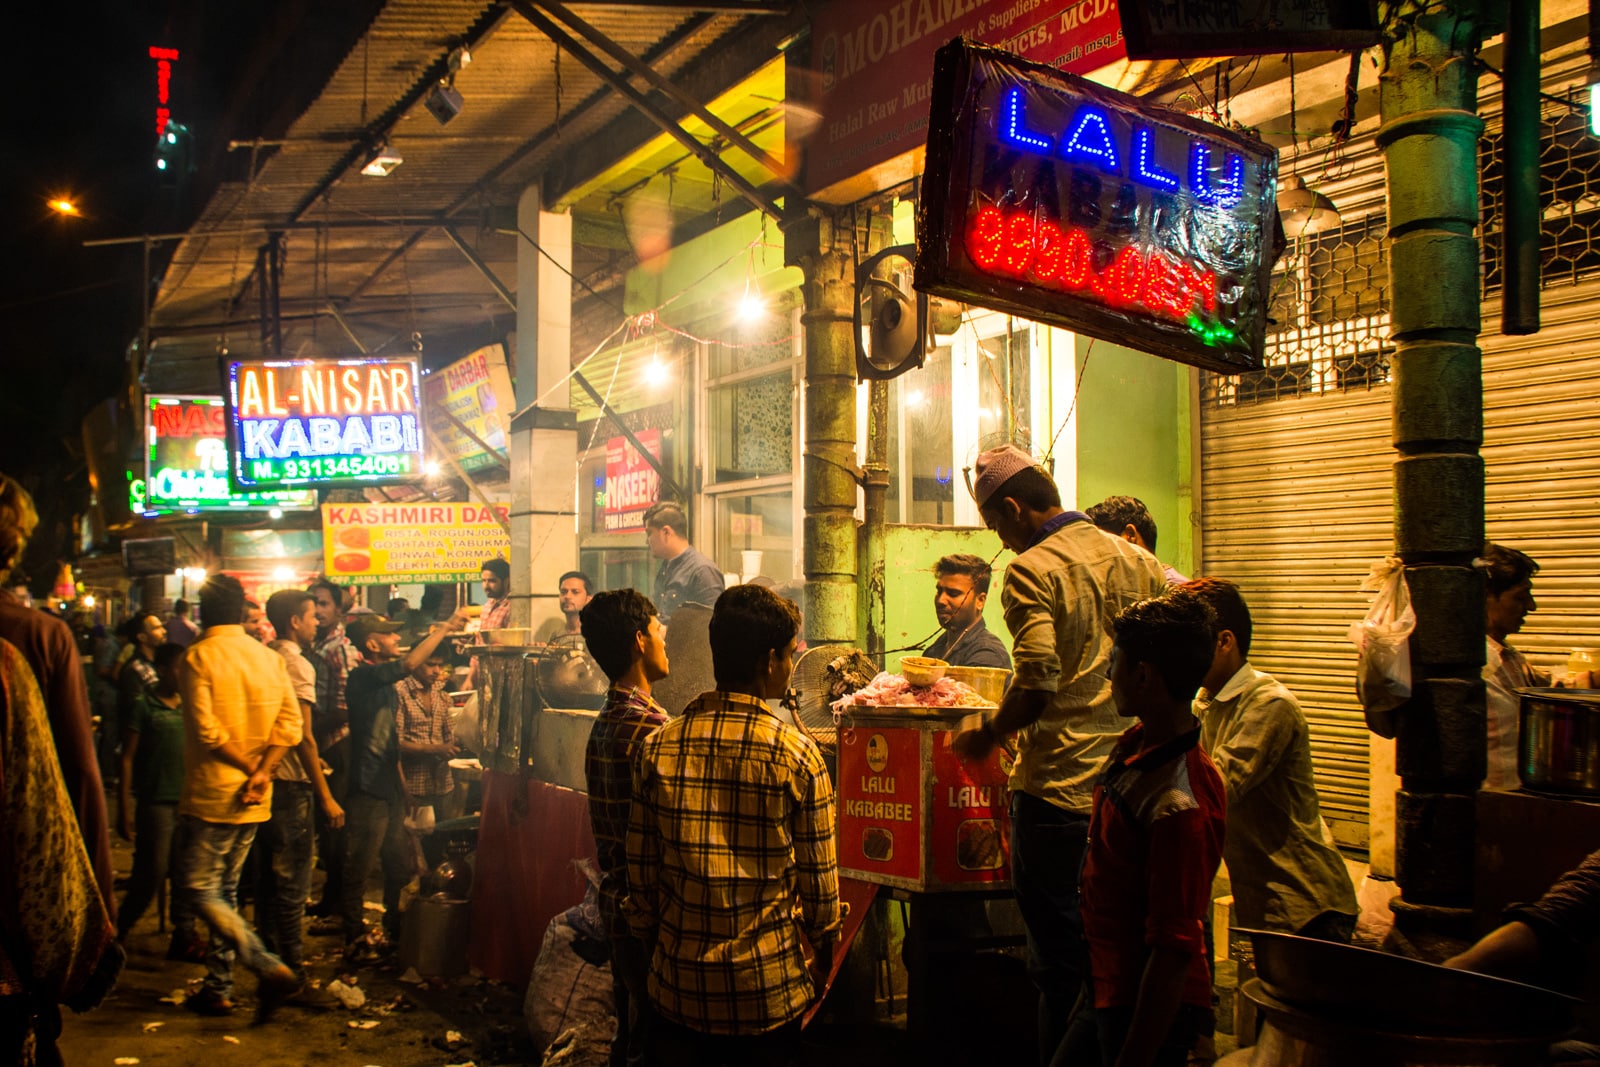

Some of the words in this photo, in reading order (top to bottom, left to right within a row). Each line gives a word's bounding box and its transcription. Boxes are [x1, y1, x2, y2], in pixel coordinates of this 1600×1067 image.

[977, 20, 986, 37] &
[988, 0, 1040, 32] Suppliers
[1059, 0, 1116, 34] MCD.
[829, 108, 865, 144] Halal
[867, 96, 899, 126] Raw
[1000, 86, 1246, 210] LALU
[447, 354, 490, 392] DARBAR
[241, 366, 413, 418] AL-NISAR
[243, 414, 419, 459] KABABI
[254, 463, 280, 480] M.
[329, 506, 453, 525] KASHMIRI
[373, 540, 448, 549] GOSHTABA,
[446, 550, 492, 558] KORMA
[386, 561, 430, 570] SEEKH
[433, 560, 477, 569] KABAB
[414, 573, 437, 583] GATE
[439, 572, 454, 582] NO.
[861, 775, 896, 794] LALU
[948, 785, 991, 809] LALU
[845, 799, 913, 822] KABABEE
